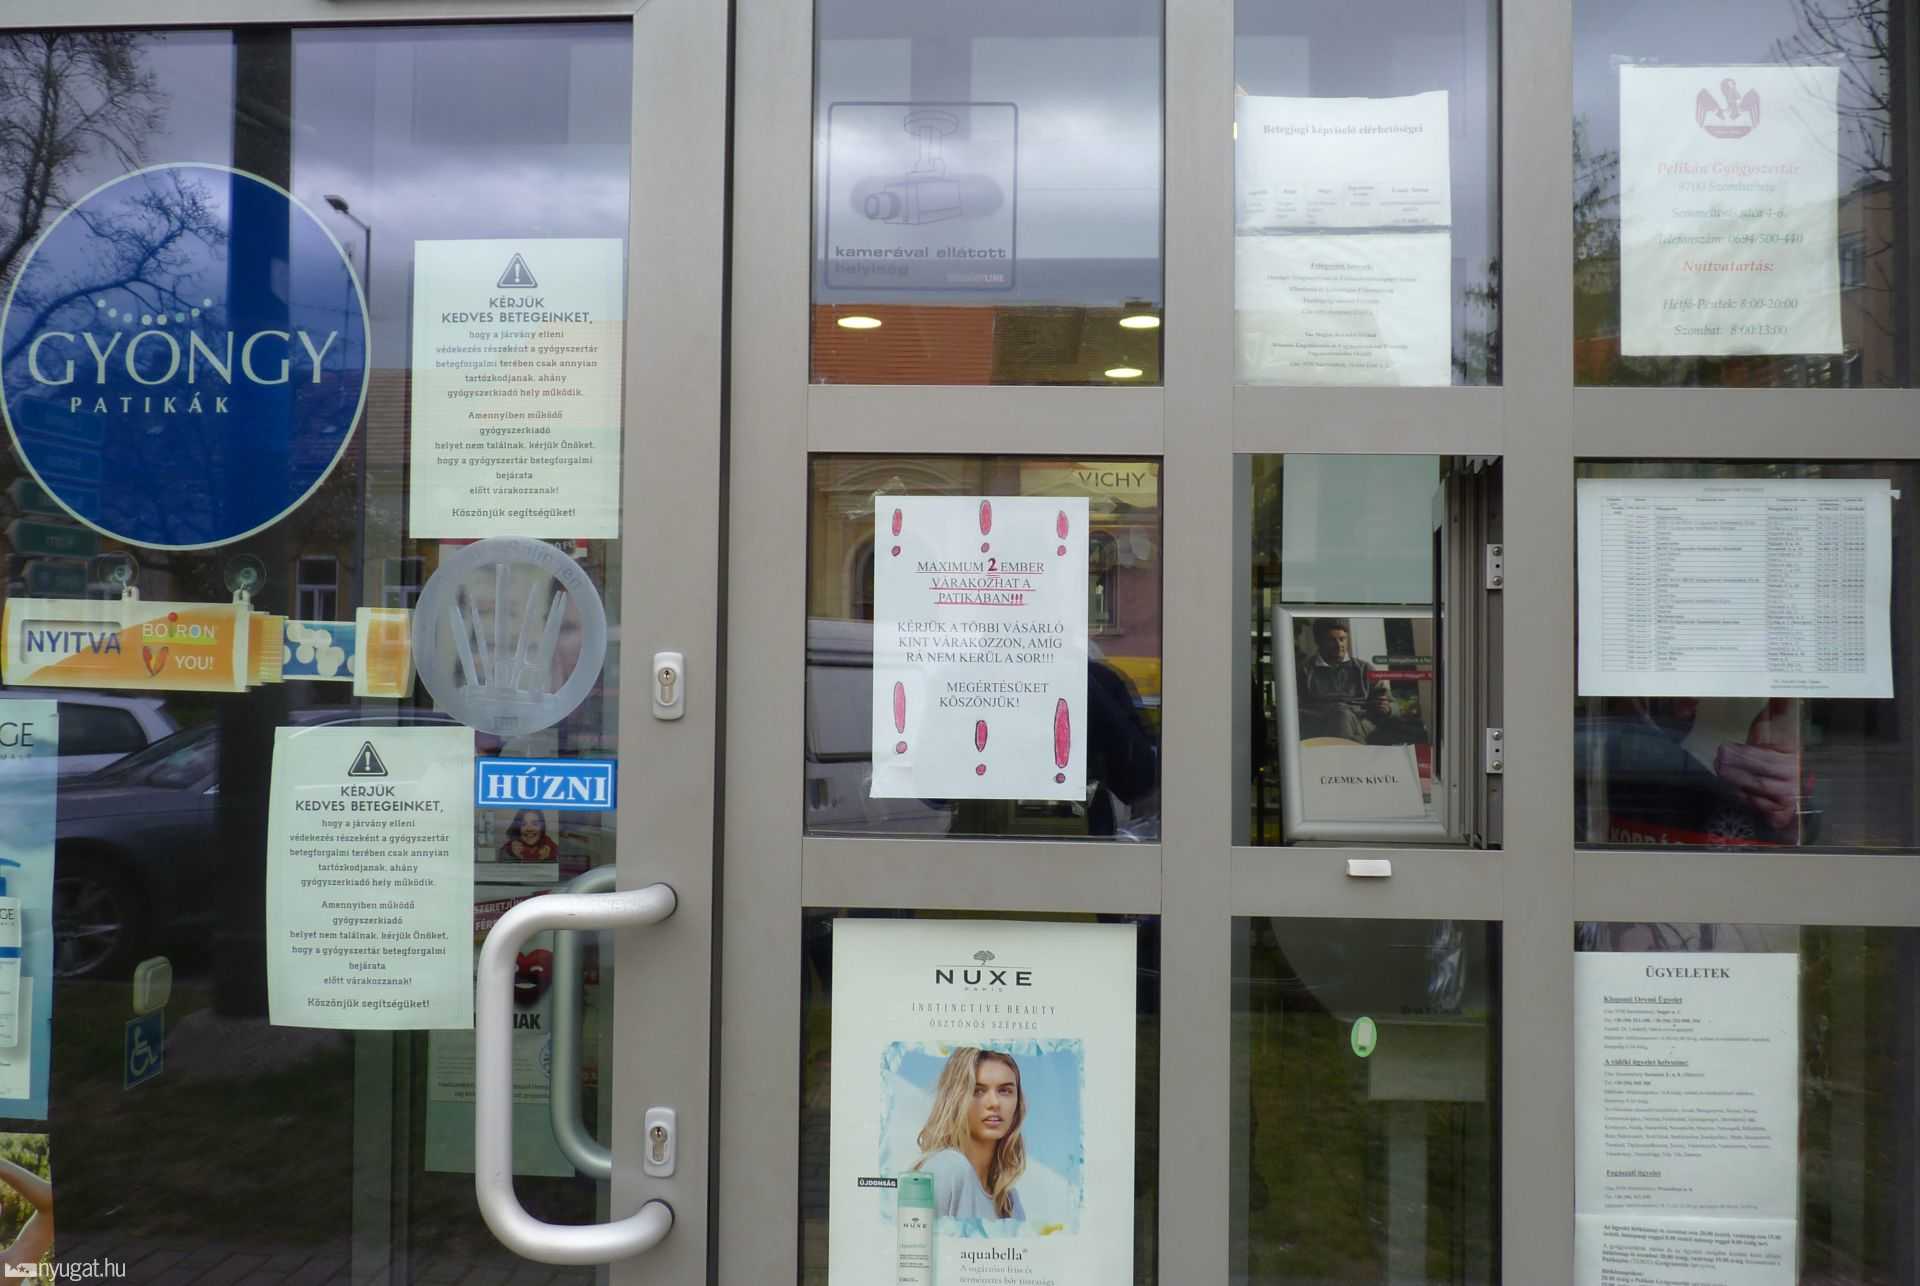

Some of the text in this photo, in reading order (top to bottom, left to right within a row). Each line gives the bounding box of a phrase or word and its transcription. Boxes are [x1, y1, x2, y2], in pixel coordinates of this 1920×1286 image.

[835, 246, 1006, 258] kamerával ellátott
[489, 296, 545, 308] KÉRJÜK
[441, 312, 593, 324] KEDVES BETEGEINKET,
[469, 331, 490, 340] hogy
[28, 313, 338, 385] GYÖNGY
[500, 360, 534, 368] terében
[536, 360, 557, 368] csak
[560, 361, 598, 370] annyian
[538, 374, 567, 384] ahány
[520, 389, 540, 399] hely
[70, 392, 229, 413] PATIKÁK
[468, 411, 526, 422] Amennyiben
[435, 442, 464, 451] helyet
[529, 442, 559, 451] kérjük
[437, 457, 458, 467] hogy
[530, 456, 593, 466] betegforgalmi
[496, 472, 534, 482] bejárata
[1078, 471, 1146, 488] VICHY
[452, 508, 576, 519] Köszönjük segítségüket!
[918, 558, 1044, 573] MAXIMUM 2 EMBER
[932, 576, 1031, 589] VÁRAKOZHAT A
[938, 590, 1023, 604] PATIKÁBAN!!!
[142, 615, 216, 640] BOIRON
[898, 618, 1064, 634] KÉRJÜK A TÖBBI VÁSÁRLÓ
[26, 630, 121, 654] NYITVA
[899, 636, 930, 648] KINT
[933, 635, 1024, 649] VÁRAKOZZON,
[175, 655, 214, 670] YOU!
[906, 650, 1054, 664] RÁ NEM KERÜL A SOR!!!
[947, 680, 1048, 694] MEGÉRTÉSÜKET
[940, 694, 1020, 708] KÖSZÖNJÜK!
[487, 766, 608, 801] HÚZNI
[1320, 775, 1364, 785] ÜZEMEN
[340, 785, 395, 797] KÉRJÜK
[296, 800, 444, 813] KEDVES BETEGEINKET,
[322, 820, 343, 830] hogy
[352, 820, 387, 830] járvány
[390, 820, 415, 828] elleni
[290, 834, 334, 842] védekezés
[336, 834, 380, 842] részeként
[390, 834, 448, 844] gyógyszertár
[290, 849, 449, 859] betegforgalmi terében csak annyian
[390, 864, 418, 874] ahány
[372, 878, 392, 888] hely
[322, 900, 377, 911] Amennyiben
[290, 930, 316, 940] helyet
[382, 931, 411, 941] kérjük
[292, 946, 313, 956] hogy
[382, 946, 446, 957] betegforgalmi
[348, 962, 386, 972] bejárata
[1646, 964, 1731, 978] ÜGYELETEK
[324, 976, 344, 985] előtt
[936, 969, 1032, 986] NUXE
[308, 998, 430, 1010] Köszönjük segítségüket!
[912, 1002, 1056, 1016] INSTINCTIVE BEAUTY
